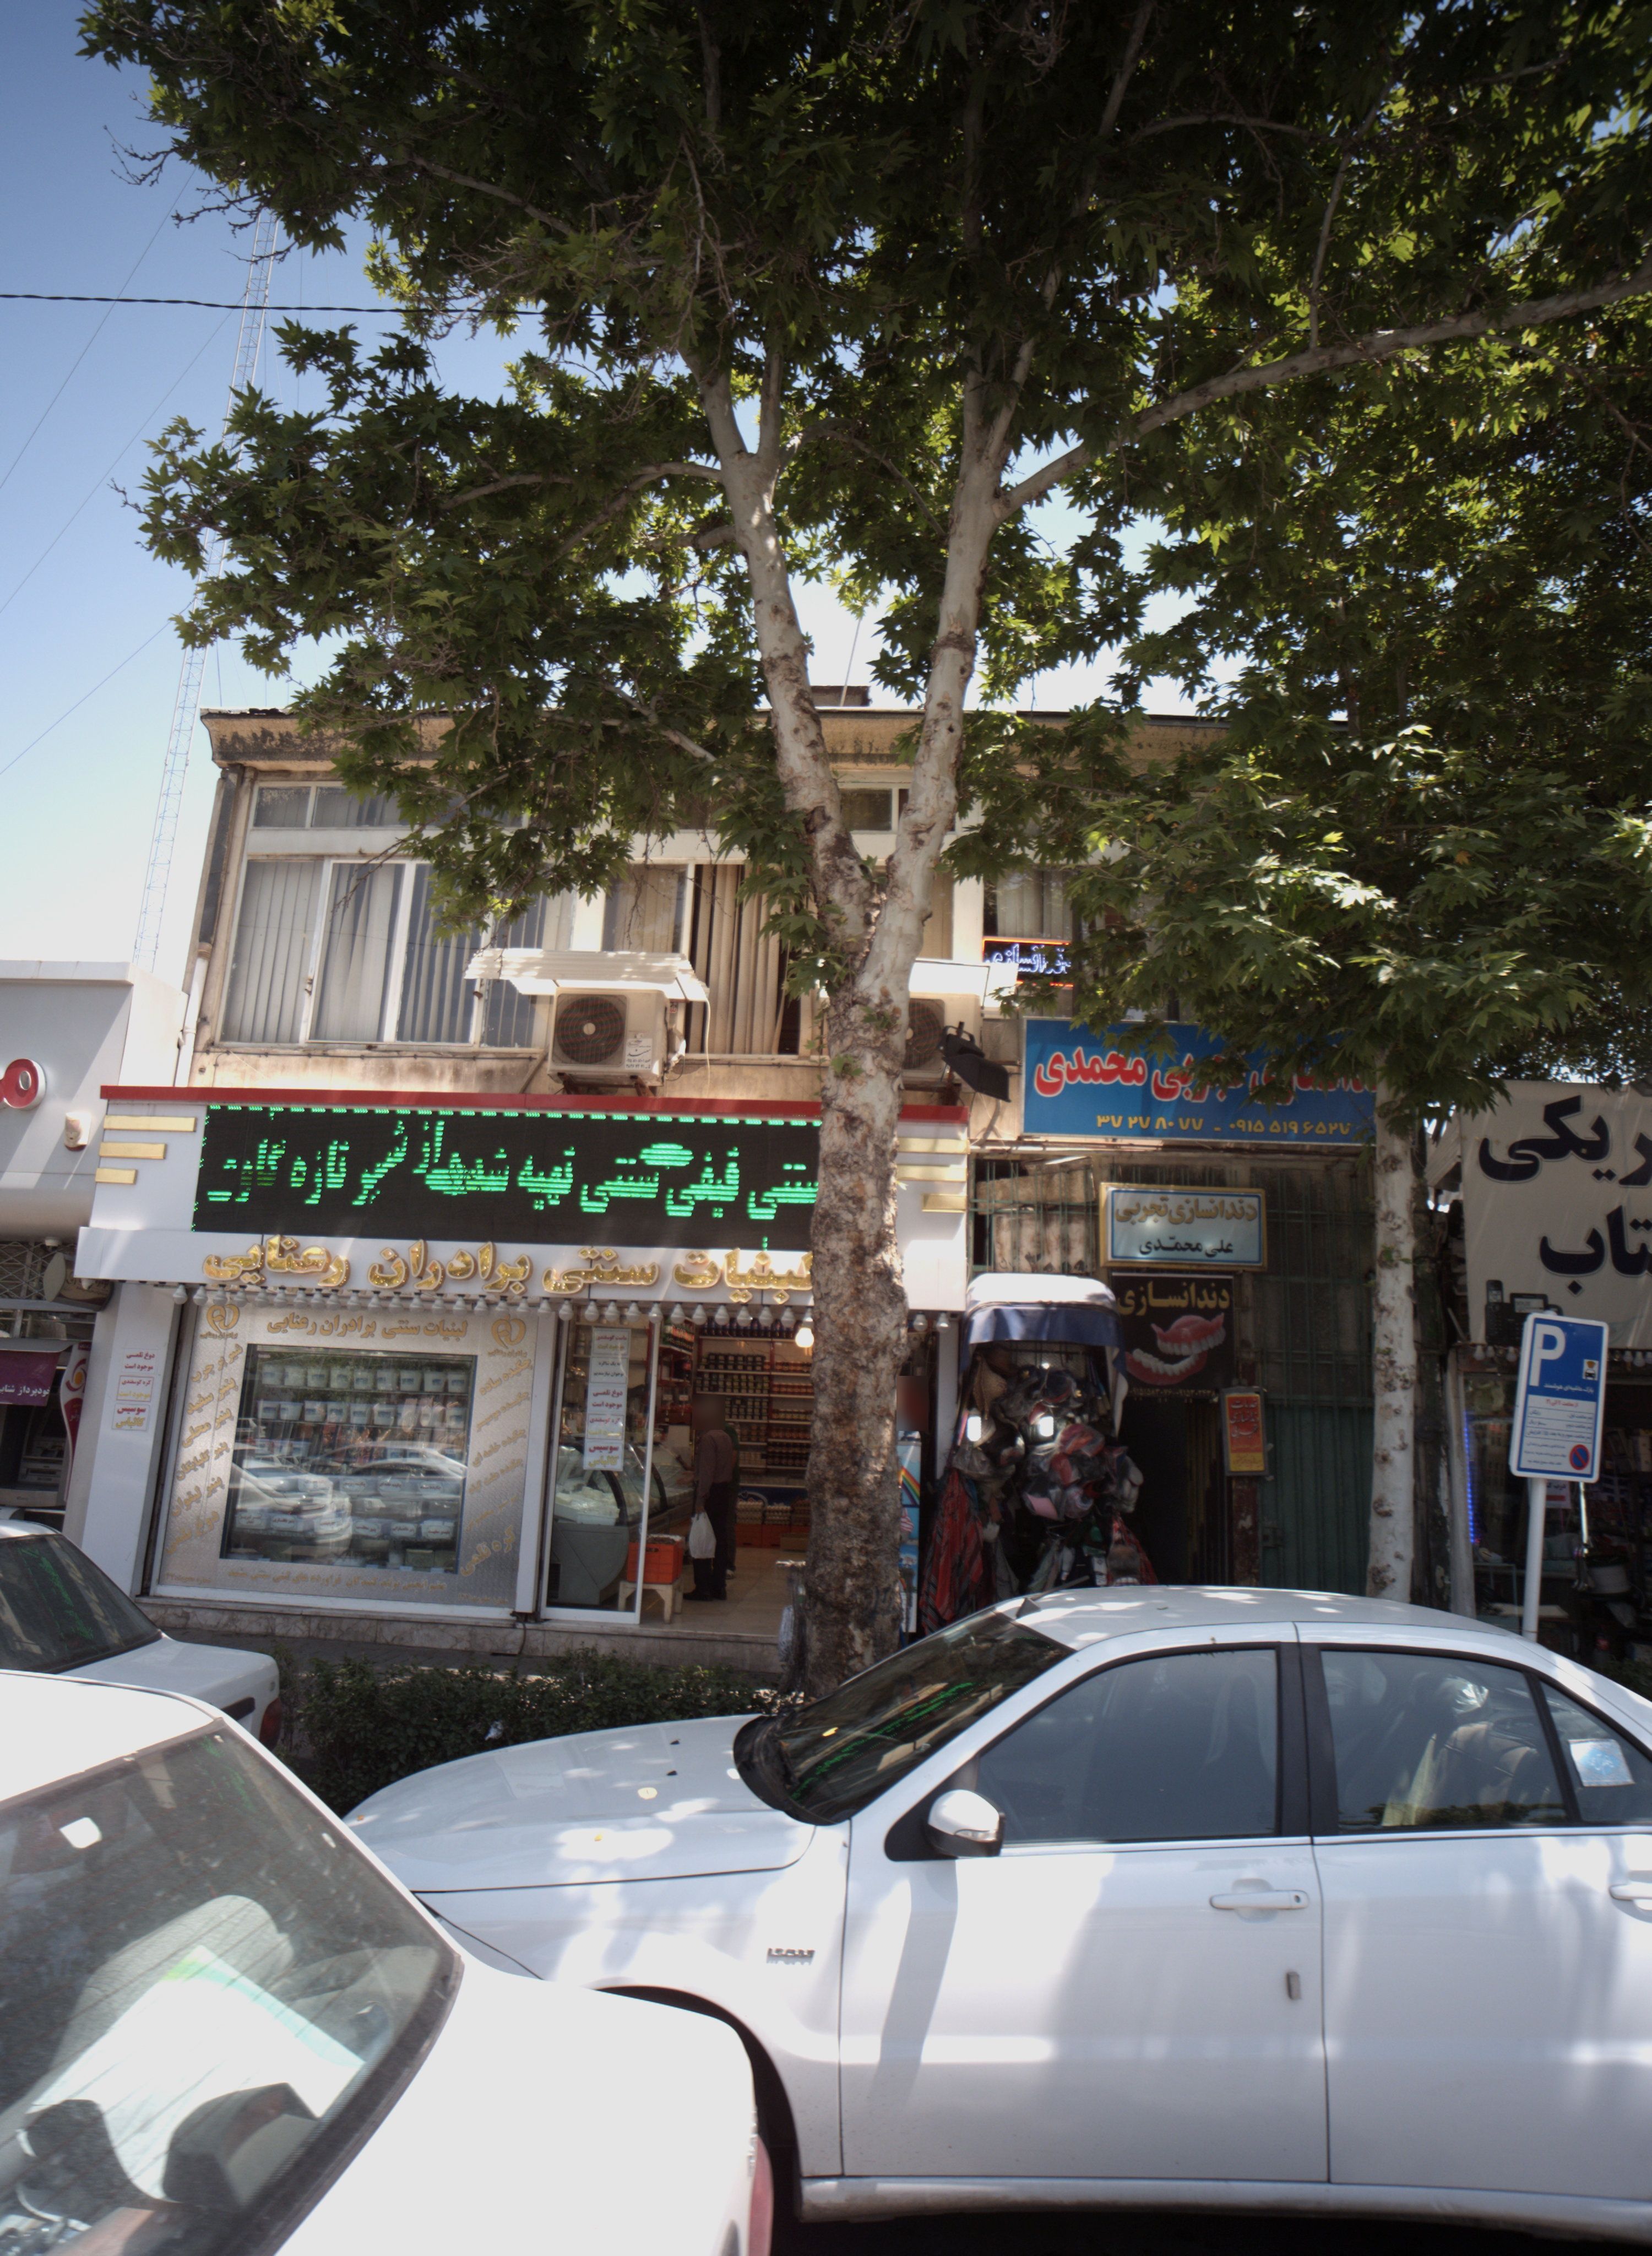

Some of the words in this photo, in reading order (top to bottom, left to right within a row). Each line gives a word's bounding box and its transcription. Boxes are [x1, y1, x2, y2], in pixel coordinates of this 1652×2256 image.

[1035, 1046, 1148, 1097] محمدی
[1479, 1094, 1652, 1186] ریکی
[1115, 1196, 1169, 1225] تجربی
[1168, 1198, 1258, 1225] دندانسازی
[203, 1234, 351, 1288] رعنایی
[1204, 1239, 1233, 1258] علی
[1539, 1205, 1652, 1296] تاب
[368, 1239, 532, 1295] برادران
[542, 1247, 660, 1295] سنتی
[1117, 1281, 1231, 1316] دندانسازی
[267, 1312, 317, 1336] رعنایی
[319, 1314, 377, 1338] برادران
[382, 1320, 421, 1339] سنتی
[423, 1320, 468, 1342] لبنیات
[1529, 1323, 1566, 1387] P
